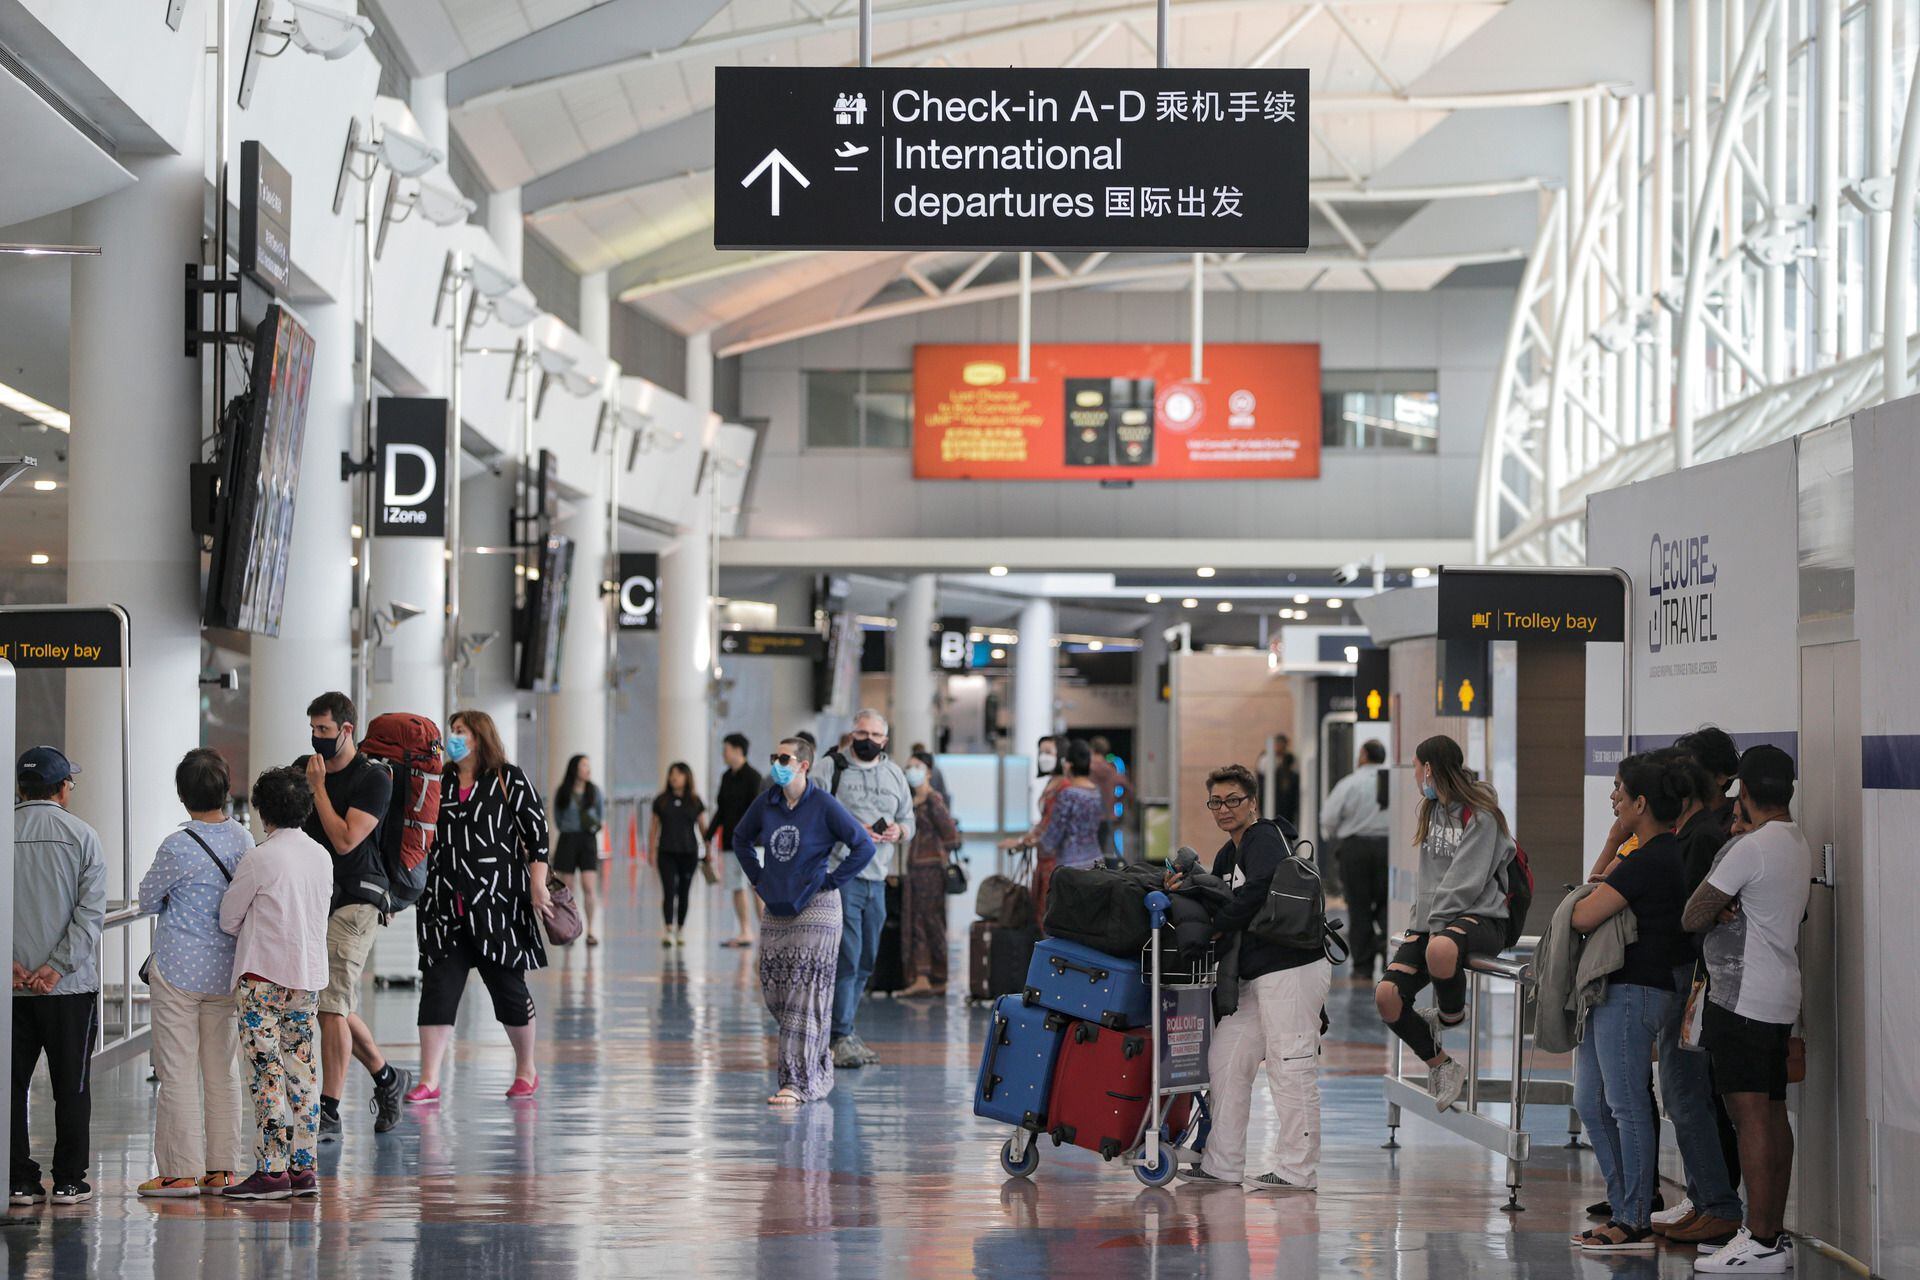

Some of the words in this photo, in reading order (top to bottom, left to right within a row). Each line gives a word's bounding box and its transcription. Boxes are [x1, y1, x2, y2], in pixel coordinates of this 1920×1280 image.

[892, 89, 1058, 122] Check-in
[1069, 90, 1146, 122] A-D
[1156, 90, 1296, 123] 乘机手续
[896, 137, 1122, 170] International
[894, 185, 1094, 225] departures
[1105, 185, 1244, 218] 国际出发
[384, 443, 437, 506] D
[620, 575, 655, 616] C
[1503, 612, 1560, 632] Trolley
[1566, 612, 1597, 632] bay
[1663, 593, 1718, 646] TRAVEL
[20, 643, 70, 661] Trolley
[74, 643, 101, 661] bay
[941, 631, 965, 660] B
[1166, 1016, 1183, 1032] ROLL
[1183, 1015, 1197, 1030] OUT
